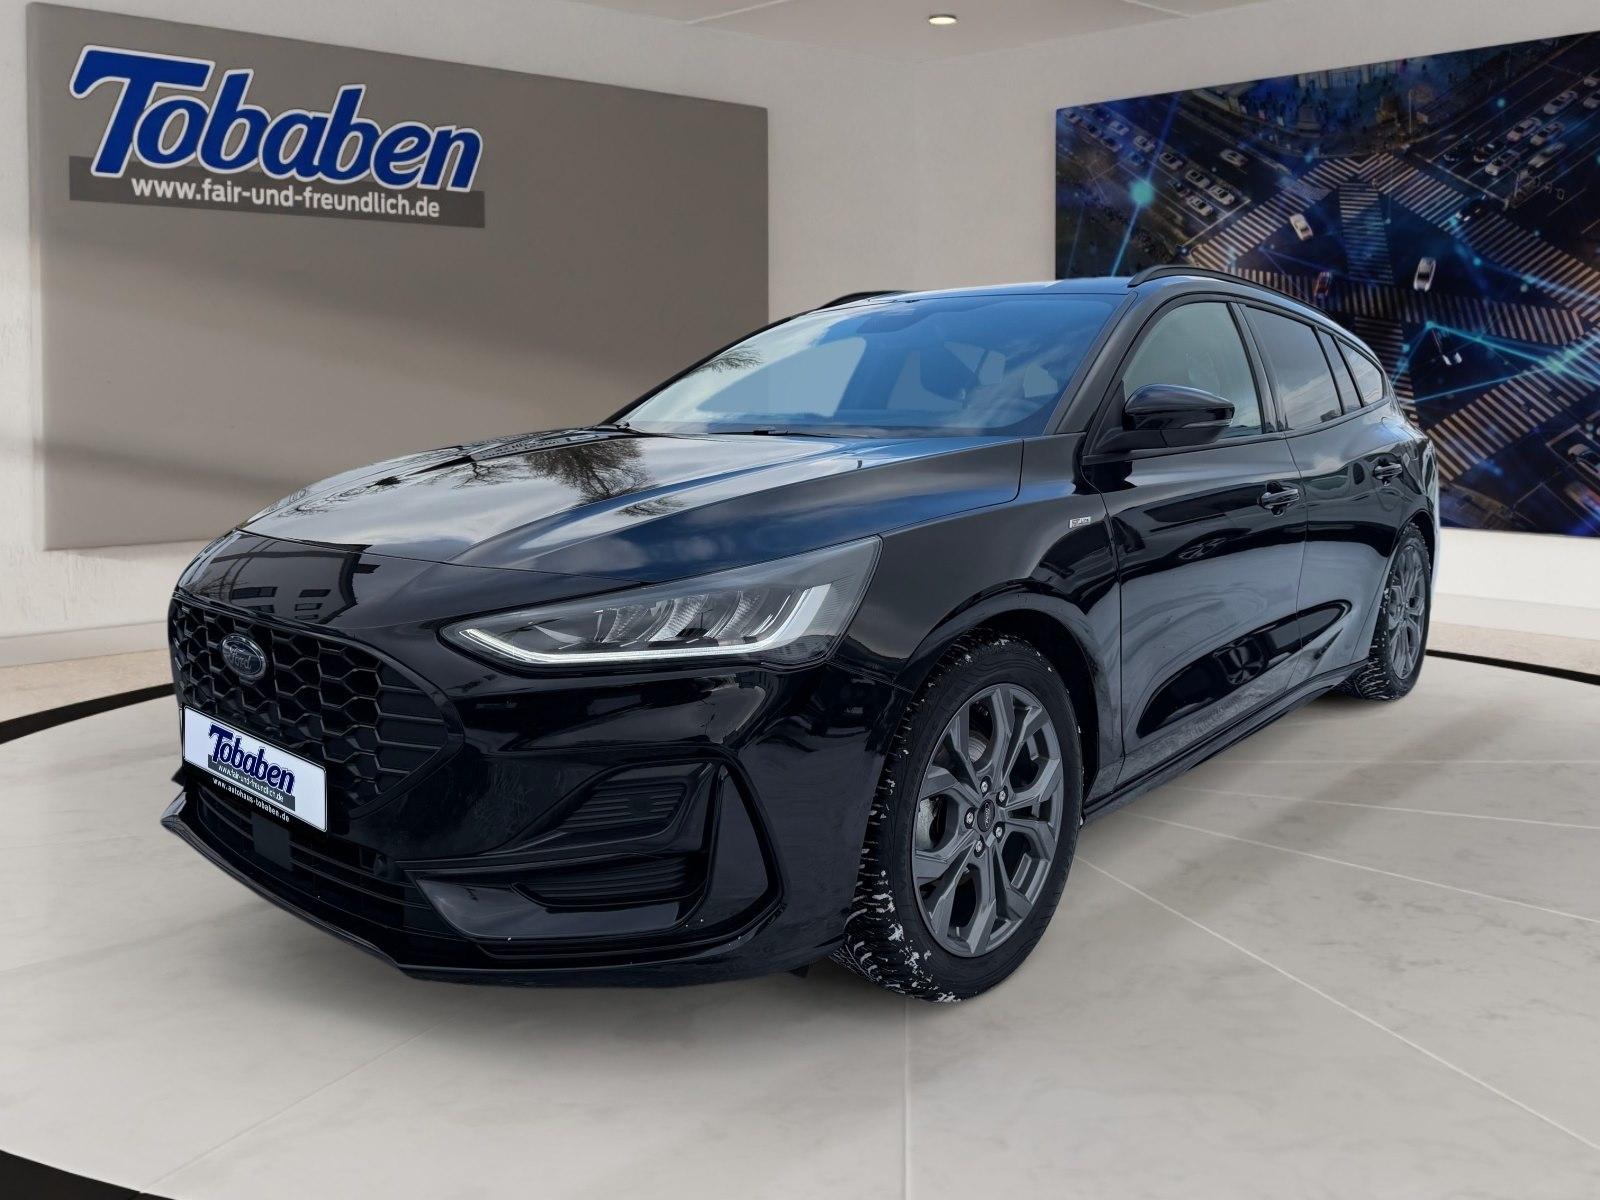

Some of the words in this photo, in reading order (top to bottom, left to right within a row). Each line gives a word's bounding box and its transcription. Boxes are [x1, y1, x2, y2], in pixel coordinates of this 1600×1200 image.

[69, 45, 483, 192] Tobaben
[131, 176, 440, 218] www.fair-und-freundlich.de
[208, 723, 295, 795] Tobaben
[212, 777, 290, 823] www.autohaus-tobaben.de
